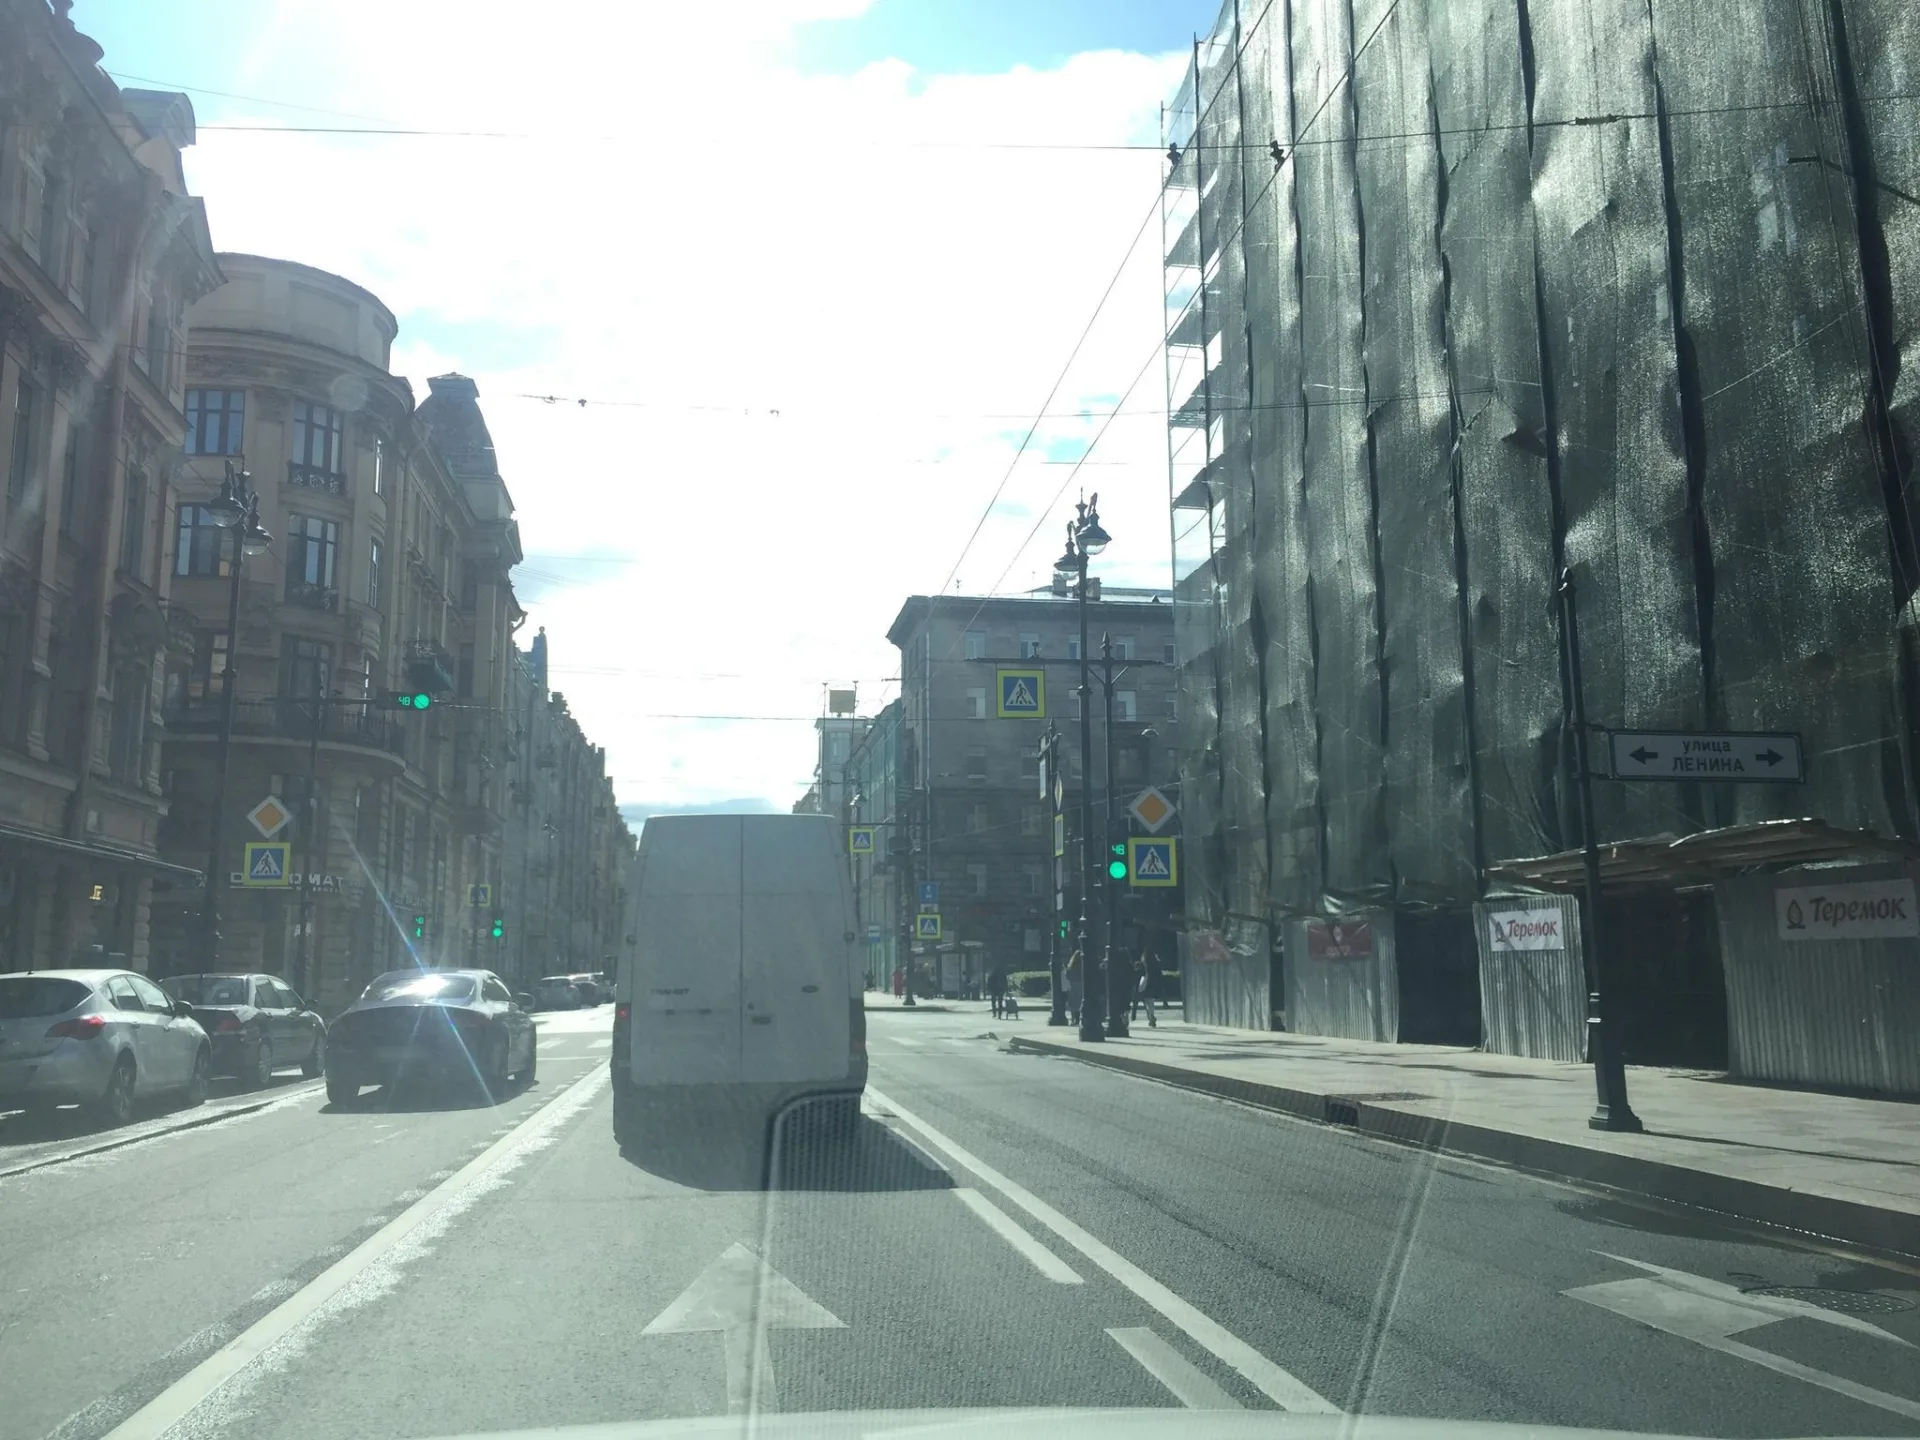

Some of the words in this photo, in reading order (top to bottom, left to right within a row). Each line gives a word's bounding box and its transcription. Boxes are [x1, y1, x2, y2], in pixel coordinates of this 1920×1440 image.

[398, 696, 411, 706] 48
[1682, 740, 1732, 755] улица
[1672, 756, 1745, 773] ЛЕНИНА
[1111, 844, 1125, 855] 48
[1808, 896, 1907, 928] Теремок
[1506, 919, 1558, 941] Теремок
